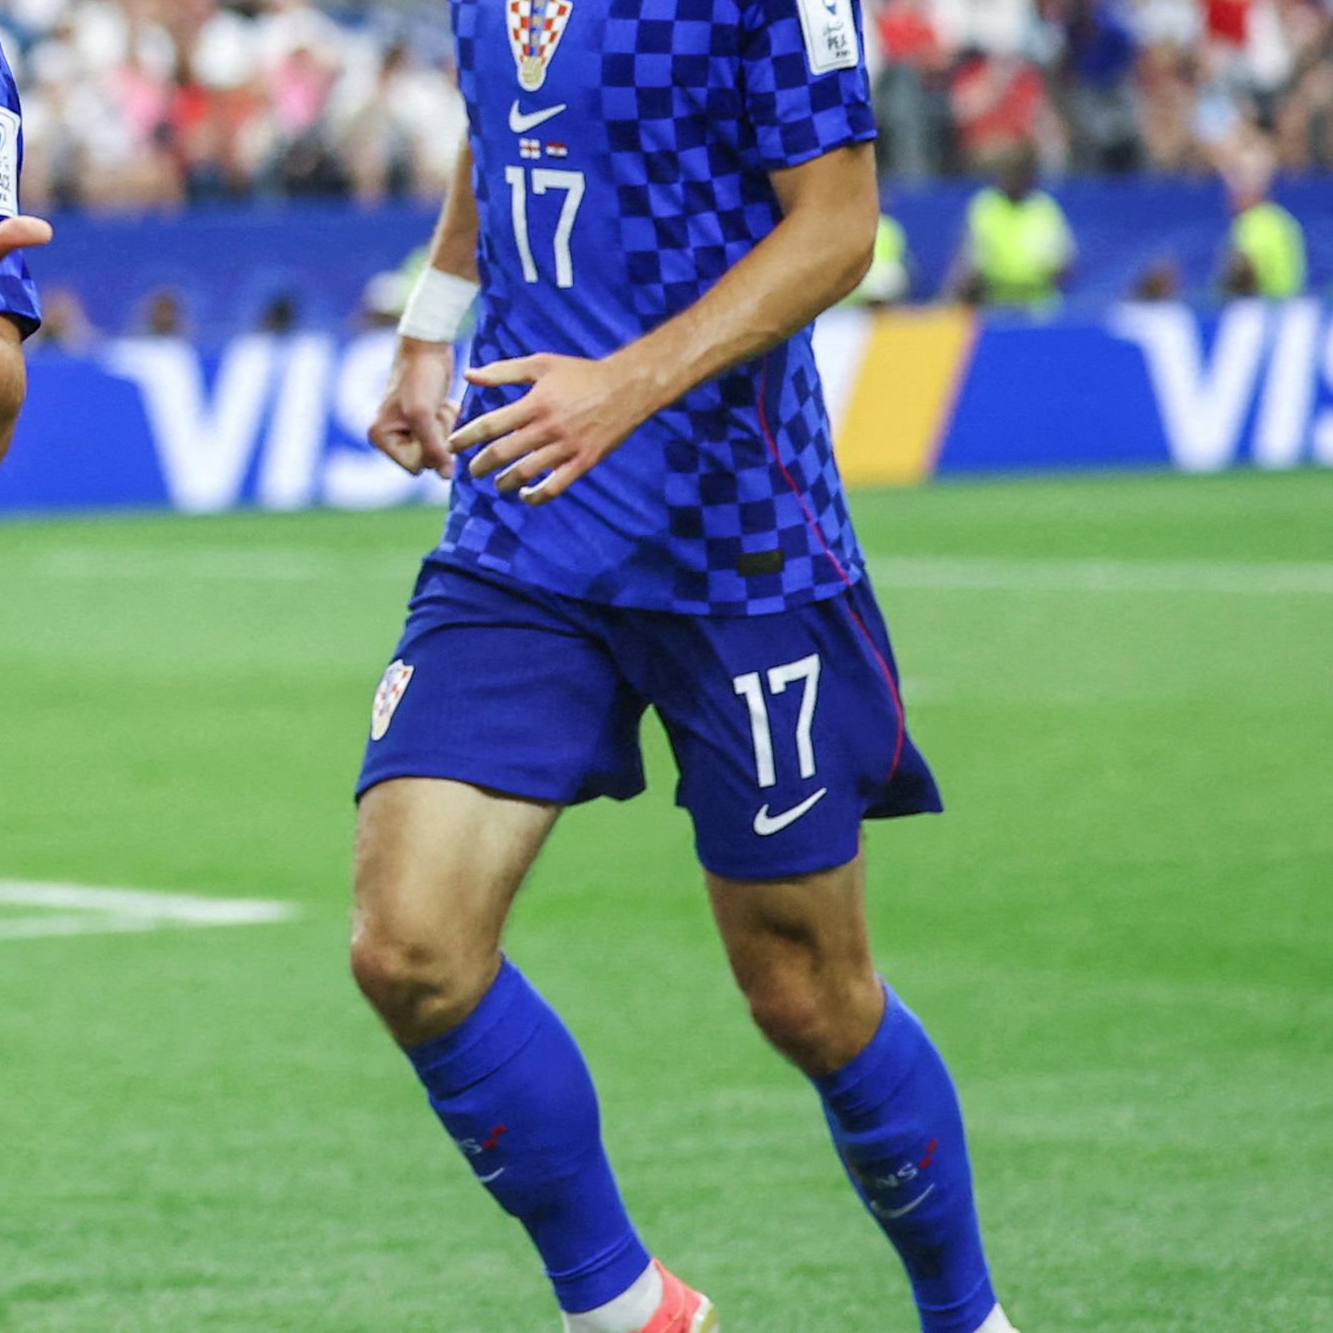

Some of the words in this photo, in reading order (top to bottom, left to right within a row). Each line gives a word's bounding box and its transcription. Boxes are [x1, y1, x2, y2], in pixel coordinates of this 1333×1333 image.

[505, 165, 586, 288] 17
[101, 334, 453, 512] VIS
[1105, 296, 1333, 472] VI
[733, 653, 820, 788] 17
